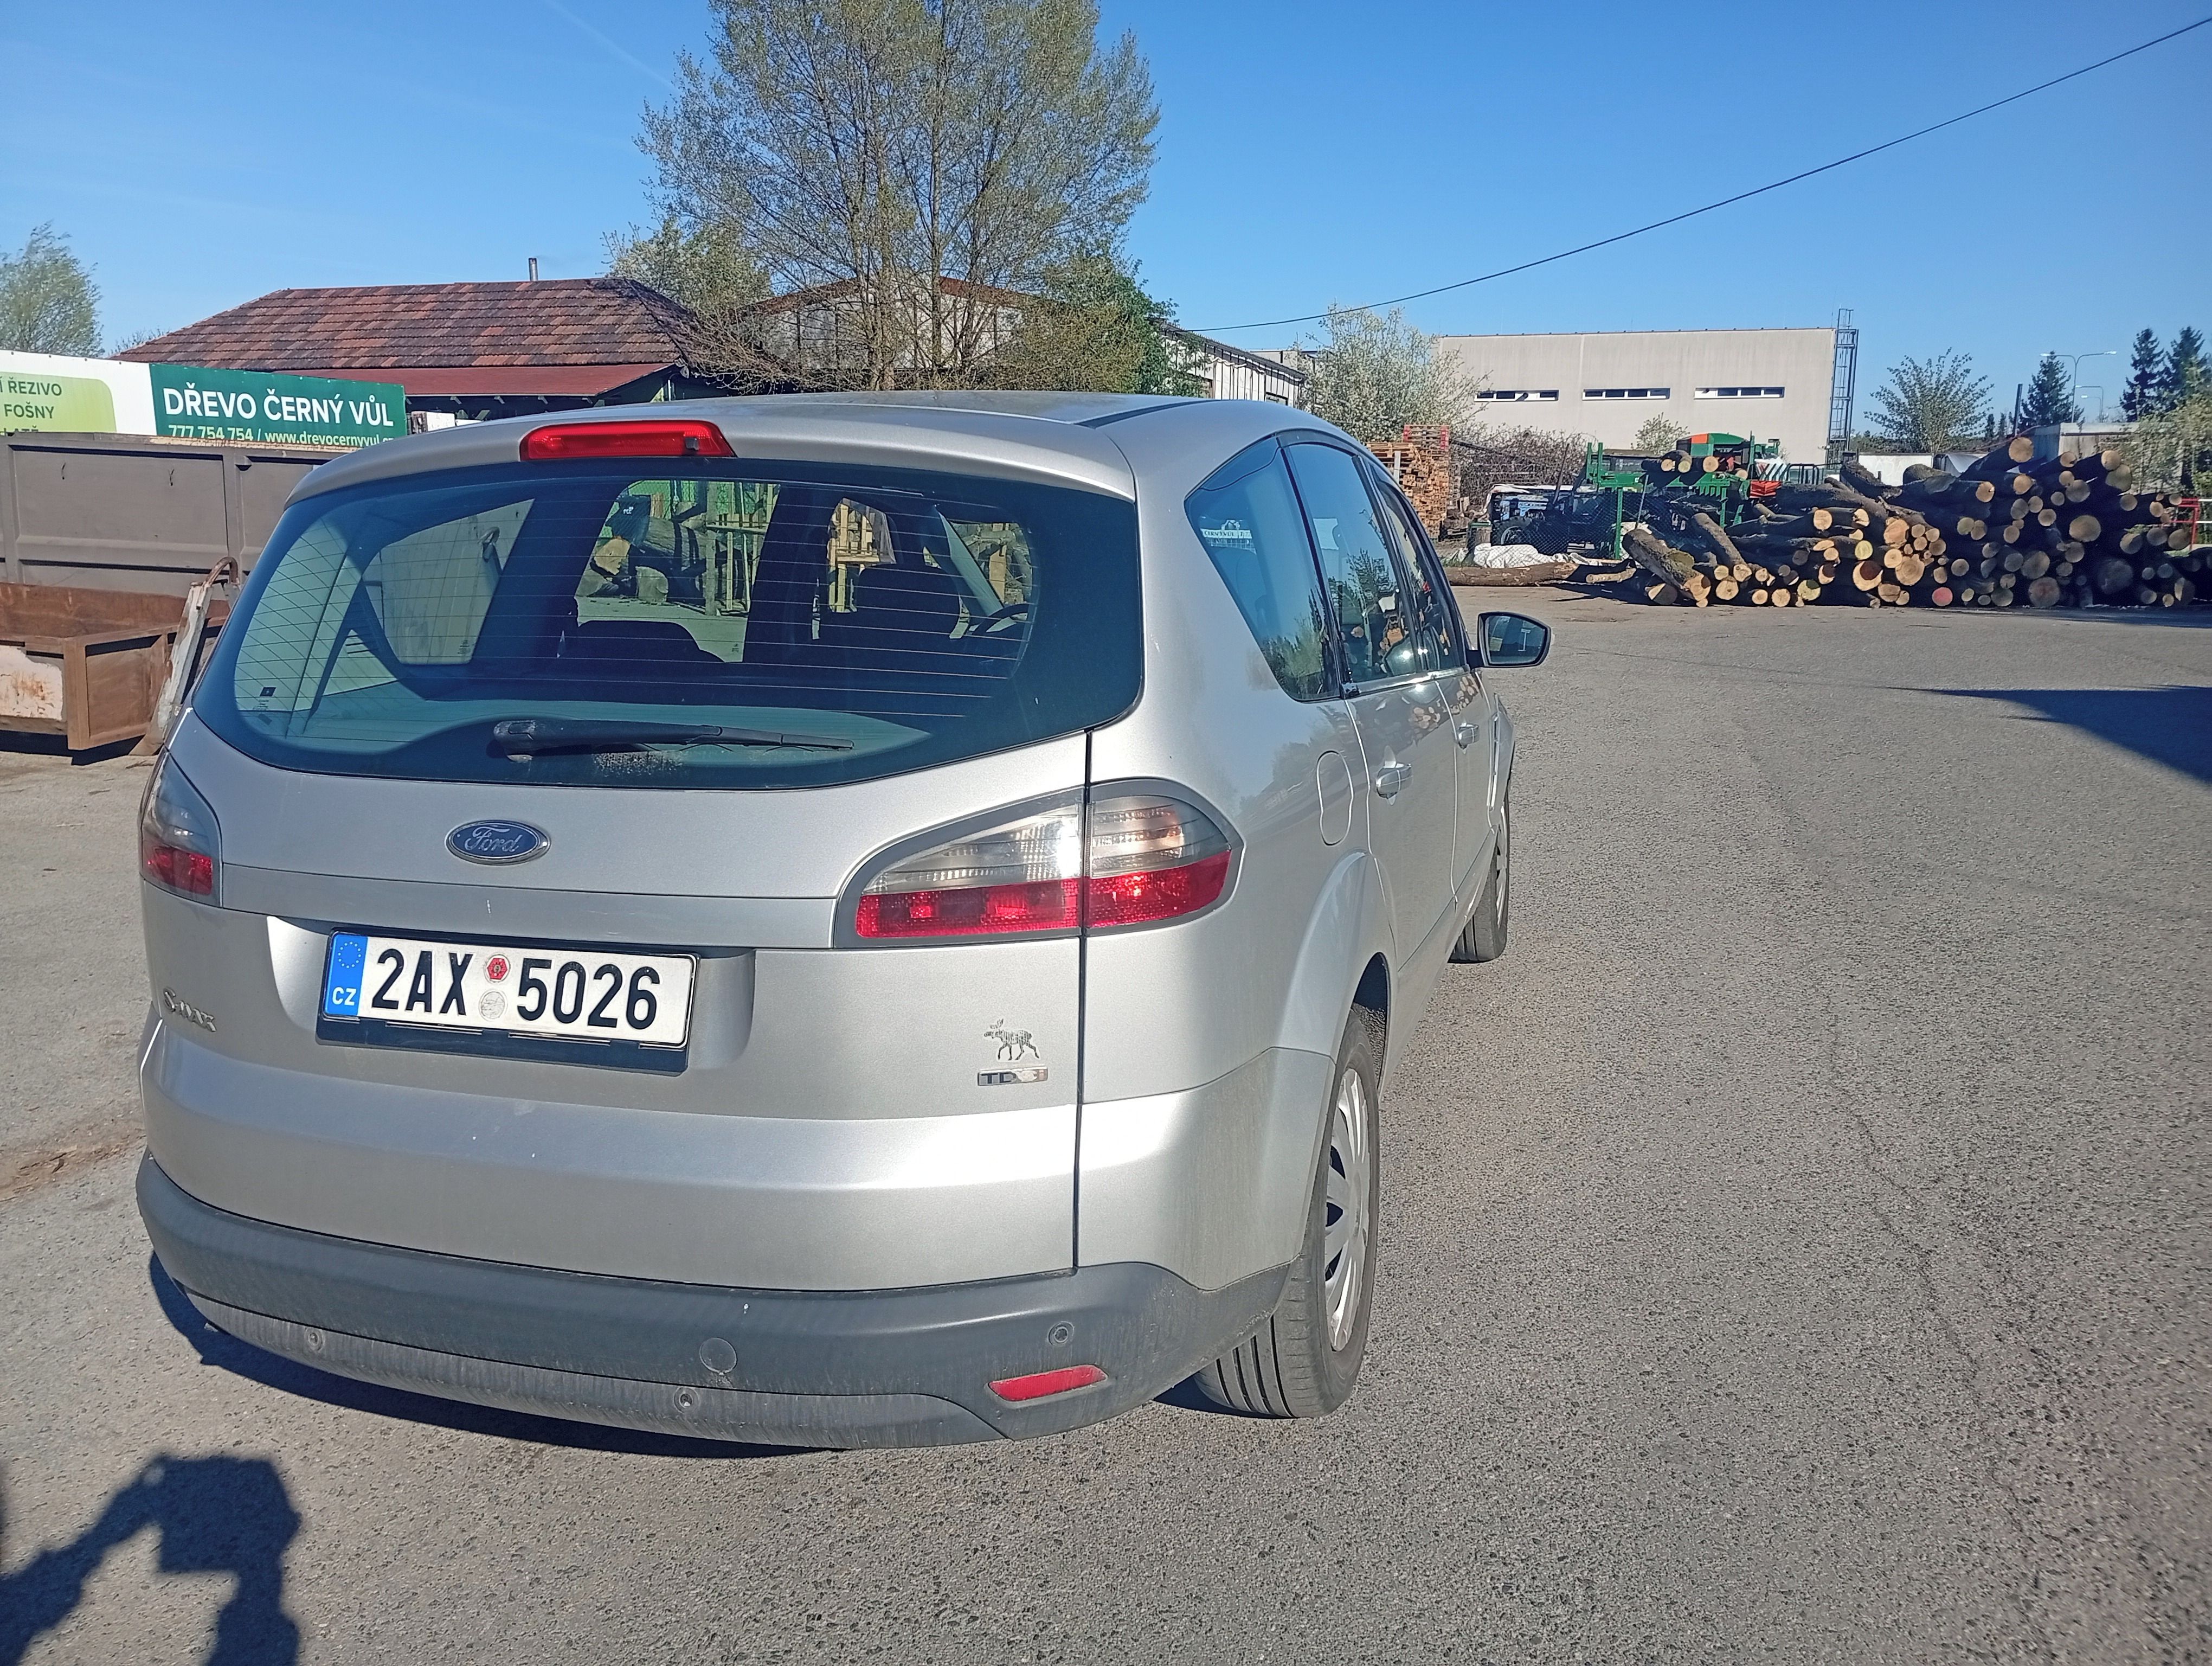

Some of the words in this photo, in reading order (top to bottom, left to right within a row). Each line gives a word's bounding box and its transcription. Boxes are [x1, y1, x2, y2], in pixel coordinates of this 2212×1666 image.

[8, 376, 62, 396] ŘEZIVO
[4, 401, 54, 419] FOŠNY
[163, 381, 257, 419] DŘEVO
[263, 388, 344, 424] ČERNÝ
[349, 395, 394, 427] VŮL
[168, 424, 194, 438] 777
[197, 426, 225, 440] 754
[227, 427, 254, 441] 754
[264, 431, 395, 447] www.drevocernyvul
[464, 826, 523, 853] Ford
[332, 986, 356, 1007] CZ
[371, 949, 473, 1016] 2AX
[517, 957, 660, 1030] 5026
[980, 1069, 1046, 1084] TDi
